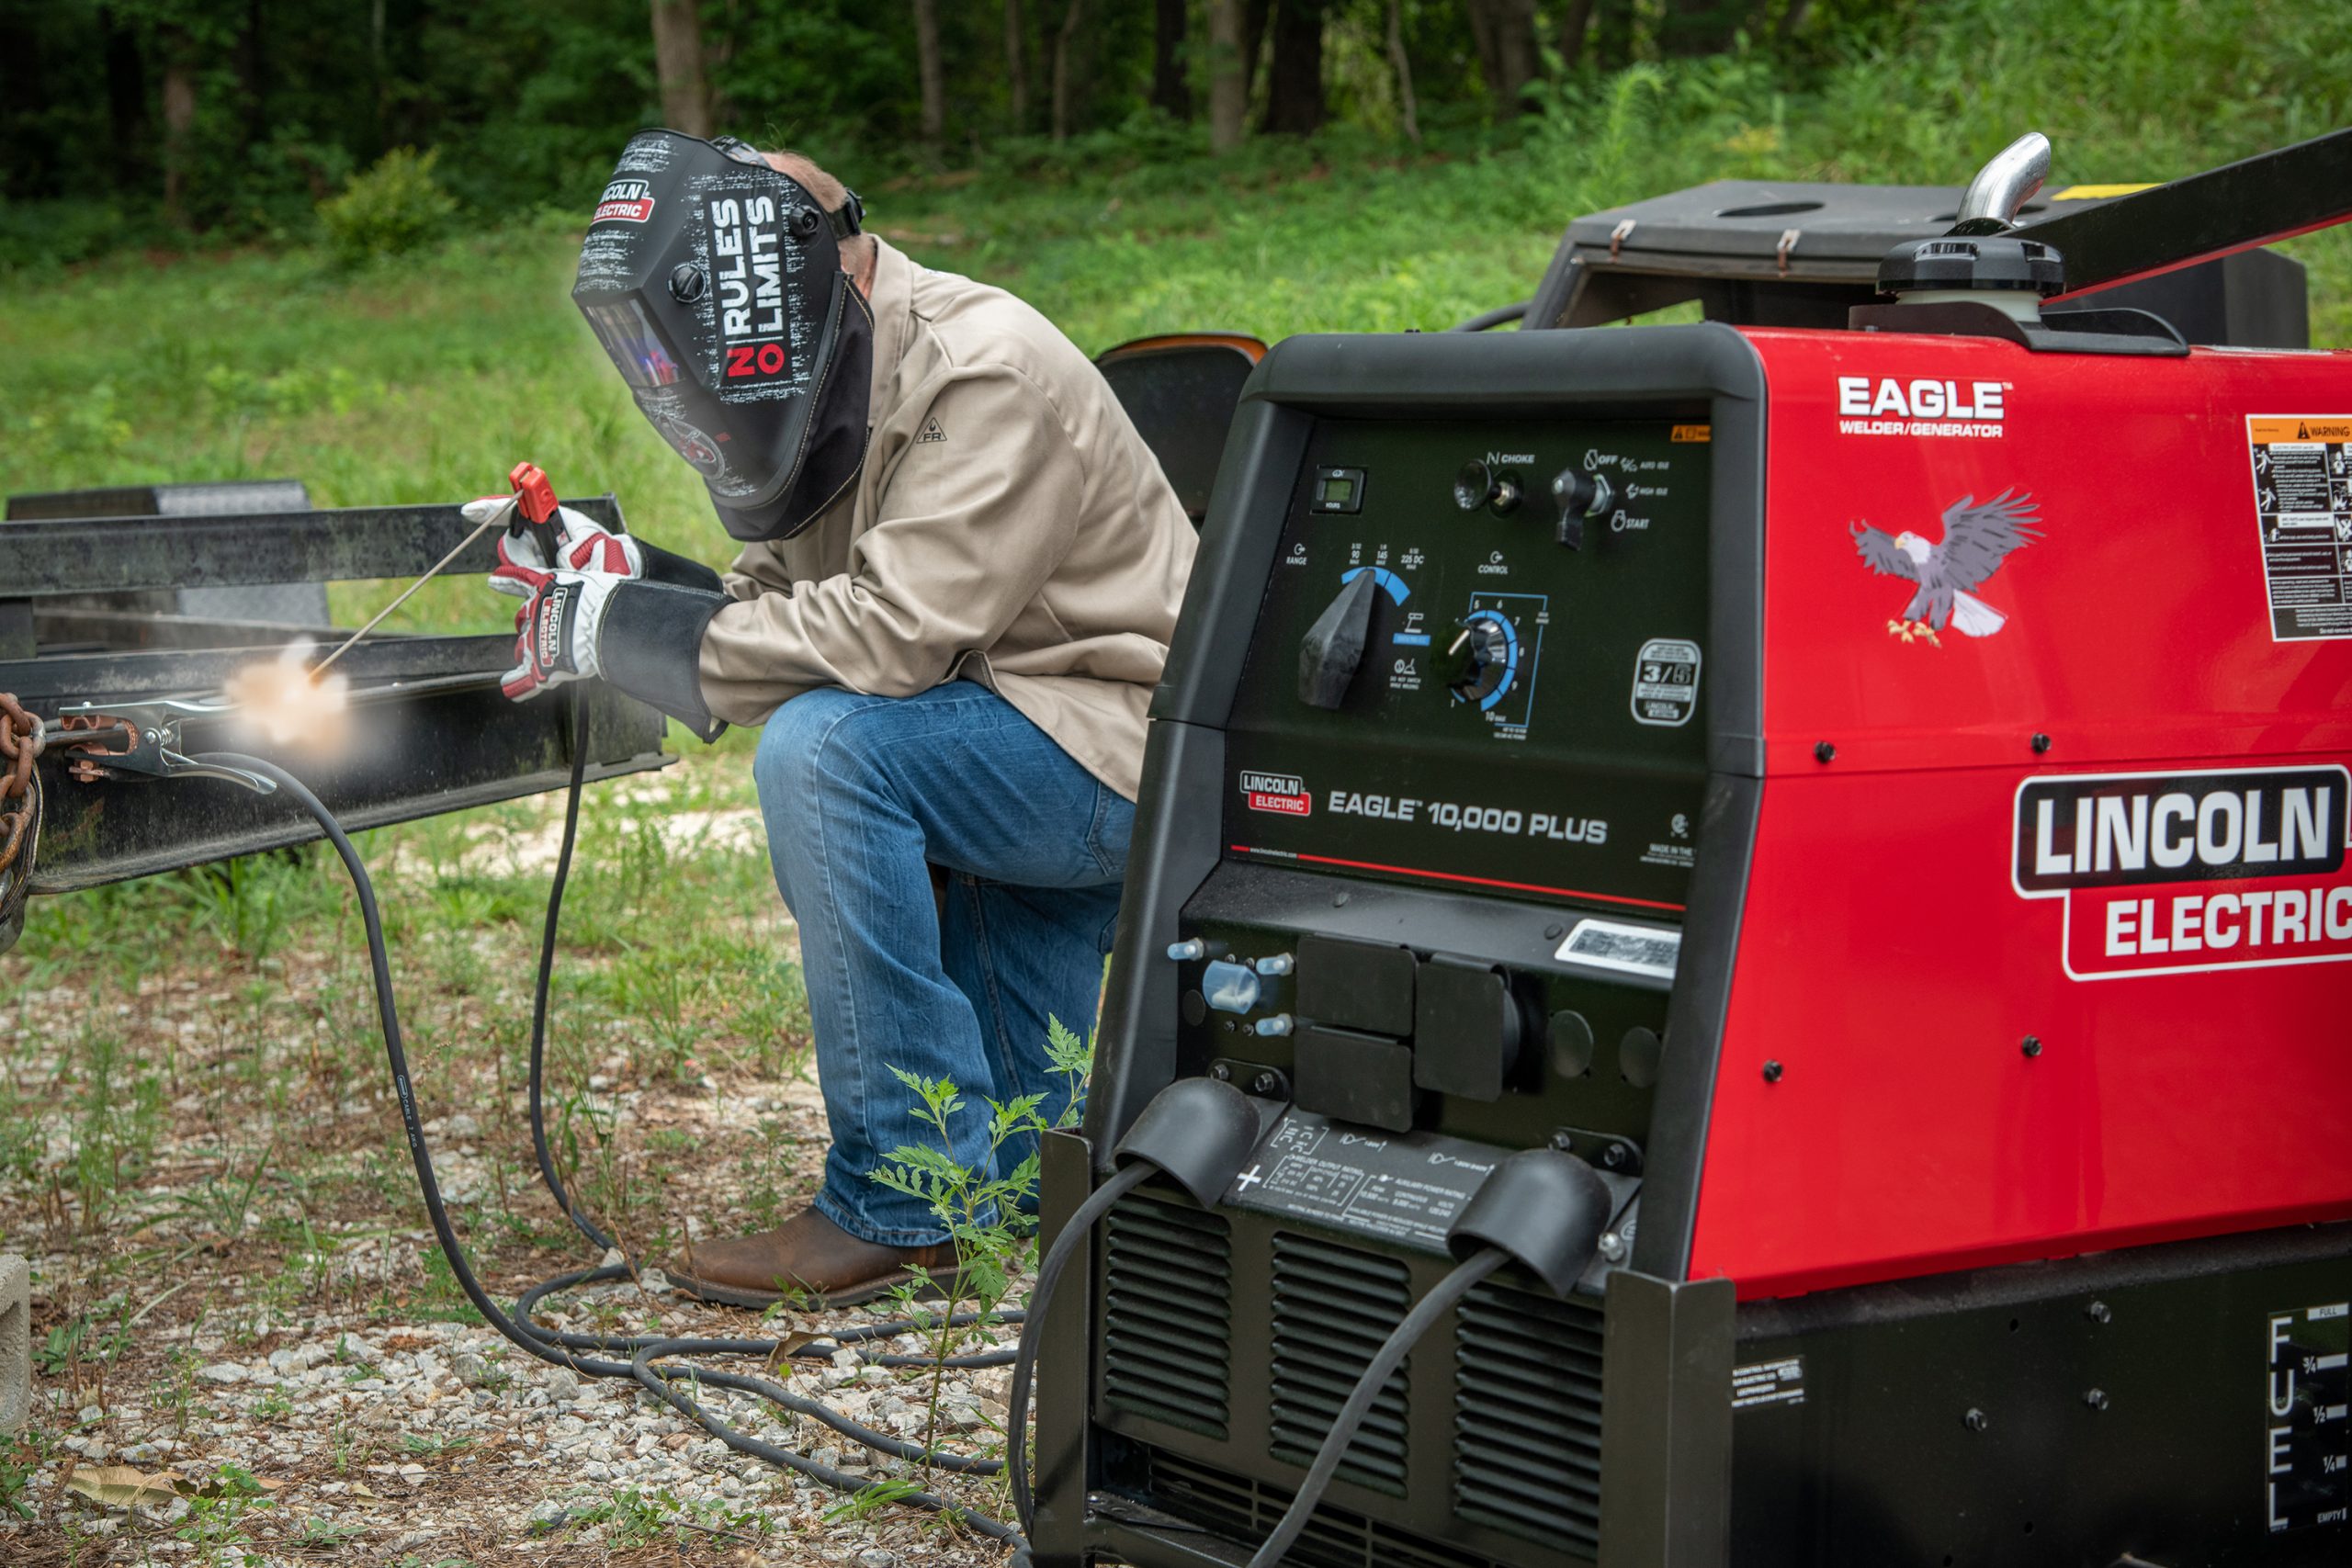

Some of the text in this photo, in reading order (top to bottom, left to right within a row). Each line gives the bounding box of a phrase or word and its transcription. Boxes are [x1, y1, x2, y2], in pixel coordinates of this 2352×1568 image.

[711, 198, 752, 336] RULES
[745, 196, 783, 333] LIMITS
[727, 343, 785, 378] NO
[923, 433, 941, 441] FR
[1839, 421, 2003, 438] WELDER/GENERATOR
[2310, 426, 2350, 436] WARNING
[1501, 454, 1534, 464] CHOKE
[1599, 455, 1618, 465] OFF
[1626, 518, 1649, 529] START
[1286, 557, 1307, 565] RANGE
[1478, 565, 1509, 575] CONTROL
[548, 592, 563, 651] LINCOLN
[1243, 774, 1298, 796] LINCOLN
[1255, 795, 1304, 812] ELECTRIC
[1428, 802, 1521, 832] 10,000
[1529, 813, 1608, 844] PLUS
[2035, 786, 2331, 875] LINCOLN
[2105, 886, 2352, 956] ELECTRIC
[2320, 1307, 2337, 1316] FULL
[2269, 1316, 2294, 1528] FUEL
[2317, 1509, 2341, 1523] EMPTY
